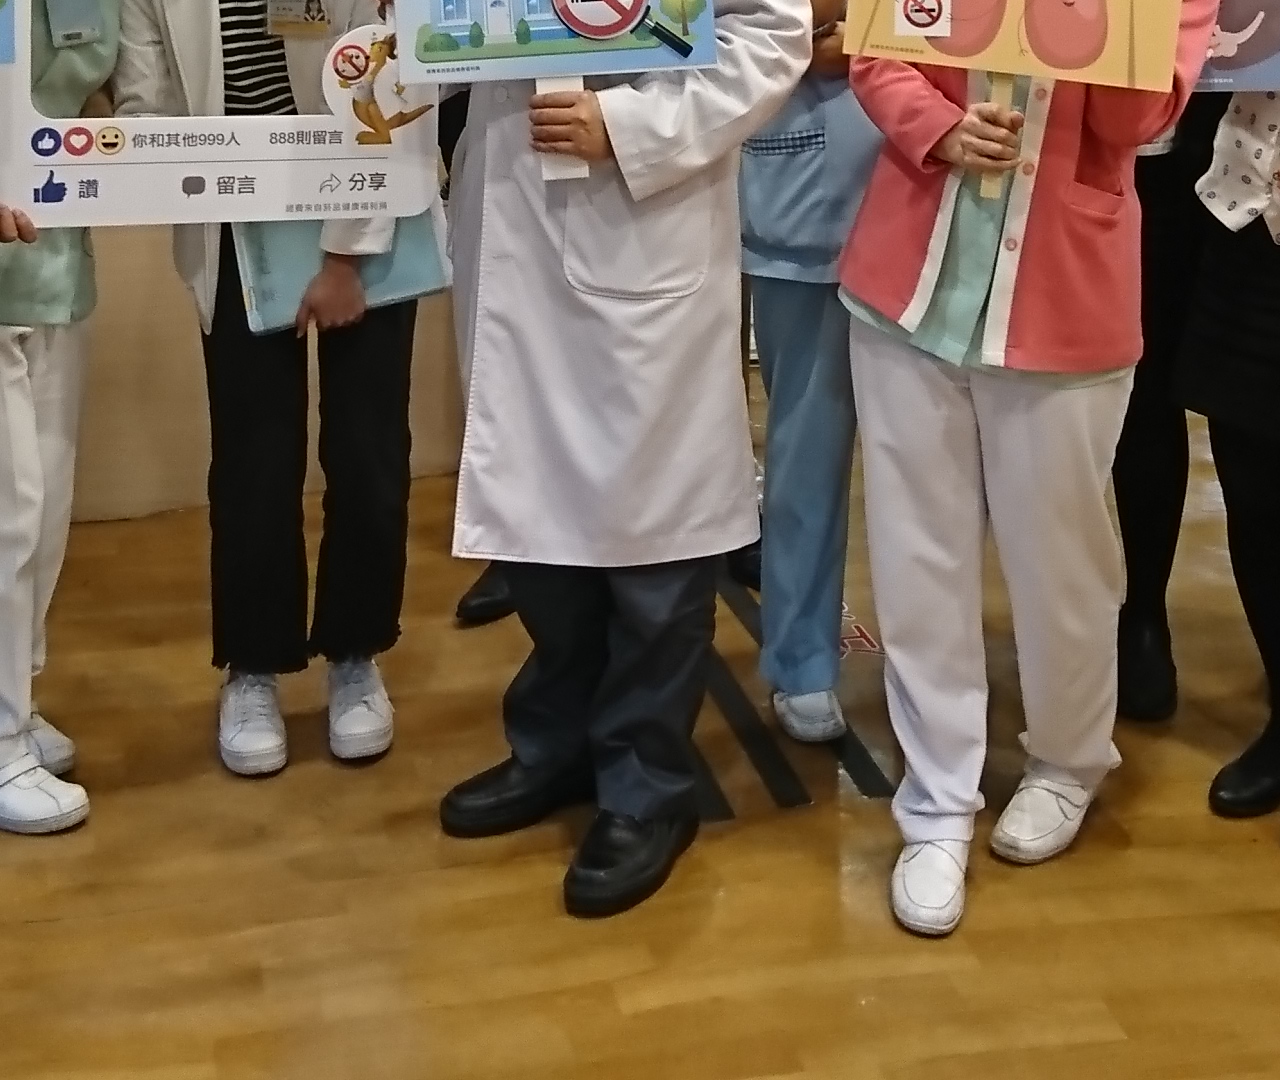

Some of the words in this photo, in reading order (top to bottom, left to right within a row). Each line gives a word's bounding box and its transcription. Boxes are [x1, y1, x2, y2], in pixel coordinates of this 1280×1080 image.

[132, 131, 242, 148] 你和其他999人
[269, 129, 344, 146] 888則留言
[216, 175, 257, 196] 留言
[348, 172, 388, 192] 分享
